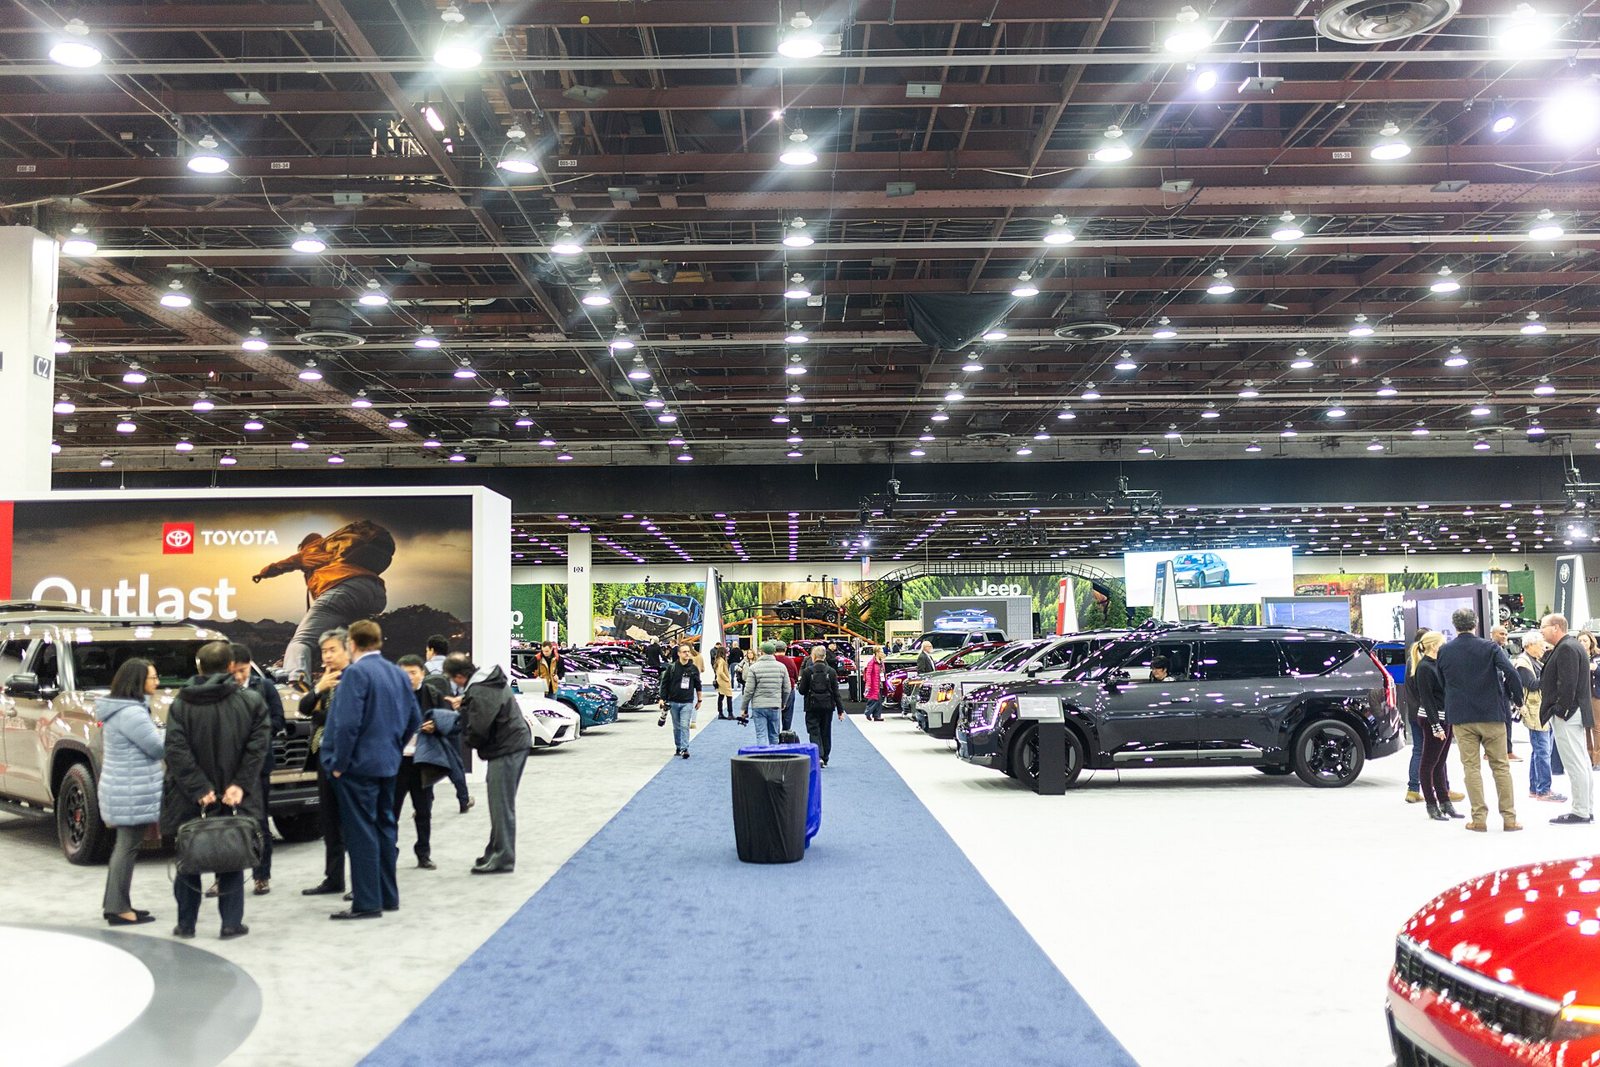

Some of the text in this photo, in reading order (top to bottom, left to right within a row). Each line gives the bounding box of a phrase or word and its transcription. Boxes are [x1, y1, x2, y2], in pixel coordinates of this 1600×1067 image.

[36, 357, 49, 377] C2
[201, 530, 279, 545] TOYOTA
[31, 573, 238, 621] Outlast
[974, 579, 1022, 597] Jeep
